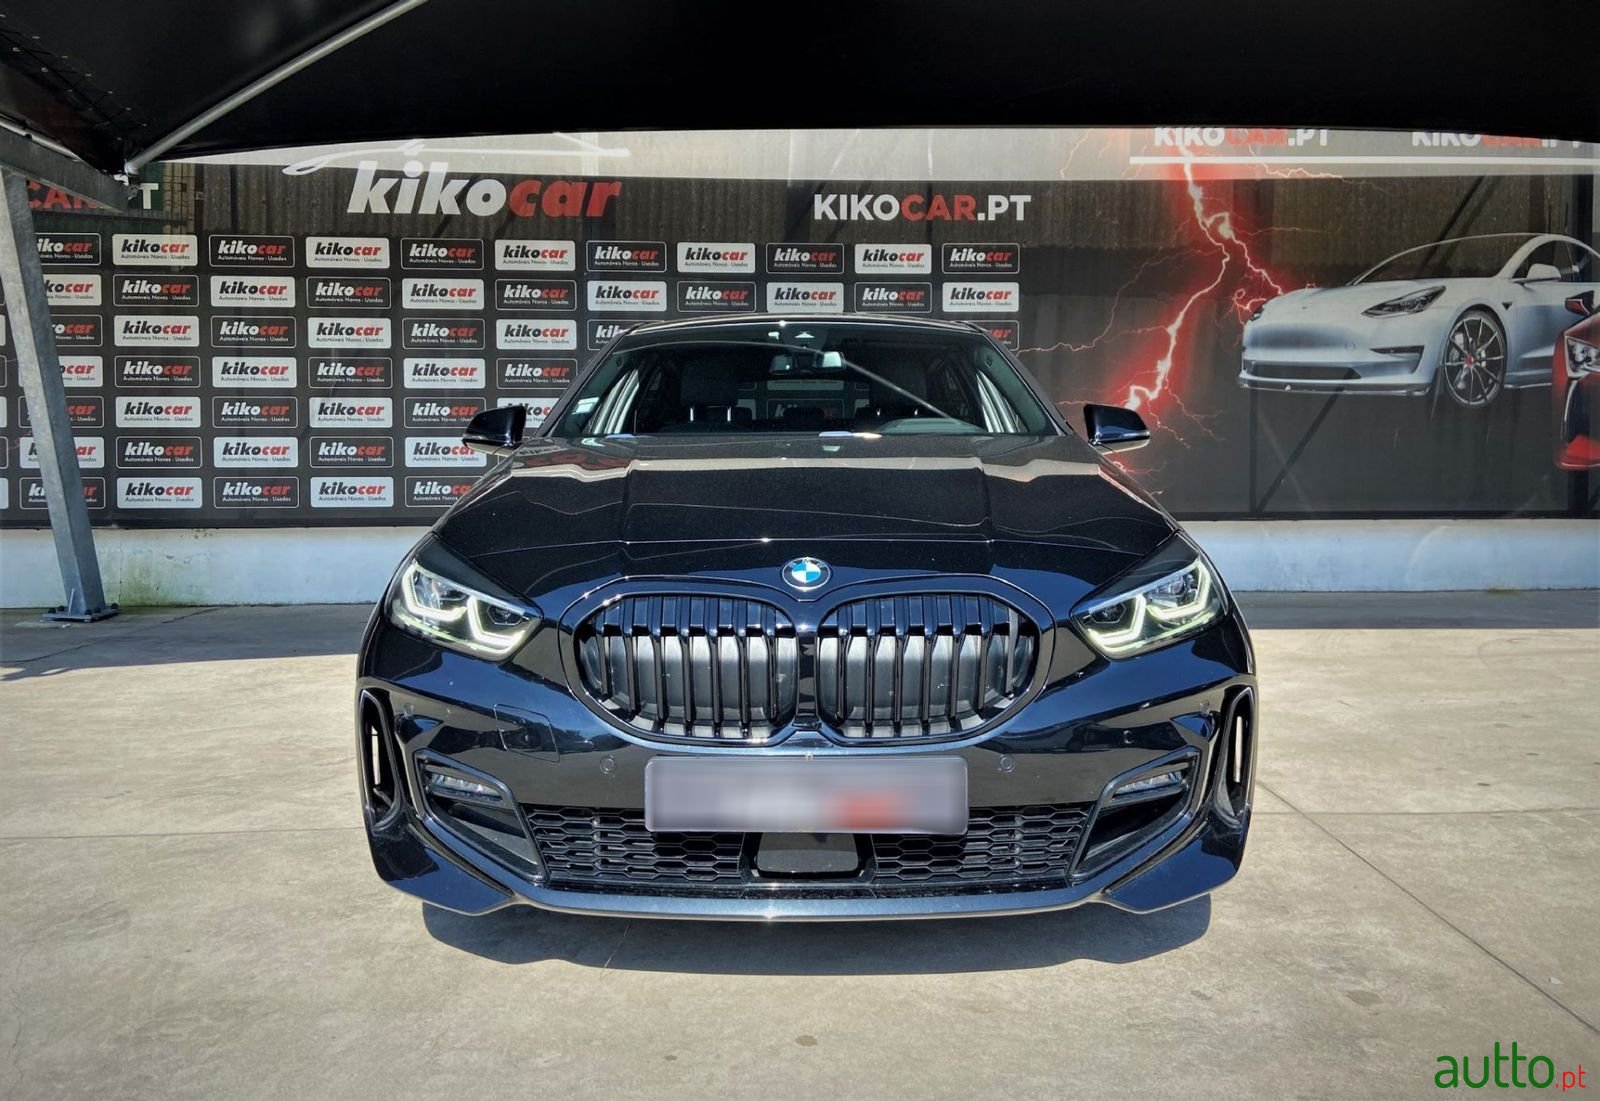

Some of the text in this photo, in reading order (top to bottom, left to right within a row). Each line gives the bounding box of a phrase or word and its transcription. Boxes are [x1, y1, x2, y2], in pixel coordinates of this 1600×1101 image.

[347, 160, 622, 217] kikocar
[814, 194, 1032, 221] KIKOCAR.PT
[37, 238, 93, 252] ikocar
[122, 240, 190, 254] kikocar
[218, 240, 287, 254] kikocar
[315, 242, 382, 256] kikocar
[410, 244, 476, 258] kikocar
[504, 245, 568, 258] kikocar
[595, 247, 658, 260] kikocar
[686, 247, 748, 260] kikocar
[775, 248, 836, 261] kikocar
[863, 249, 925, 262] kikocar
[950, 248, 1012, 261] kikocar
[44, 280, 94, 293] kocar
[122, 279, 191, 293] kikocar
[220, 281, 288, 295] kikocar
[316, 282, 383, 296] kikocar
[411, 283, 477, 297] kikocar
[504, 285, 568, 298] kikocar
[596, 286, 660, 299] kikocar
[686, 287, 748, 300] kikocar
[775, 287, 837, 300] kikocar
[863, 287, 925, 300] kikocar
[951, 287, 1012, 300] kikocar
[52, 324, 95, 334] ocar
[123, 320, 192, 334] kikocar
[220, 321, 289, 335] kikocar
[317, 322, 384, 336] kikocar
[411, 323, 476, 337] kikocar
[505, 324, 569, 337] kikocar
[124, 361, 192, 375] kikocar
[221, 361, 289, 375] kikocar
[317, 363, 384, 377] kikocar
[413, 362, 478, 376] kikocar
[505, 363, 569, 376] kikocar
[125, 401, 193, 415] kikocar
[221, 401, 290, 415] kikocar
[318, 402, 385, 416] kikocar
[413, 402, 479, 416] kikocar
[125, 441, 194, 455] kikocar
[223, 442, 290, 456] kikocar
[319, 441, 385, 455] kikocar
[126, 482, 194, 496] kikocar
[223, 482, 291, 496] kikocar
[319, 481, 386, 495] kikocar
[414, 481, 472, 495] kikoca
